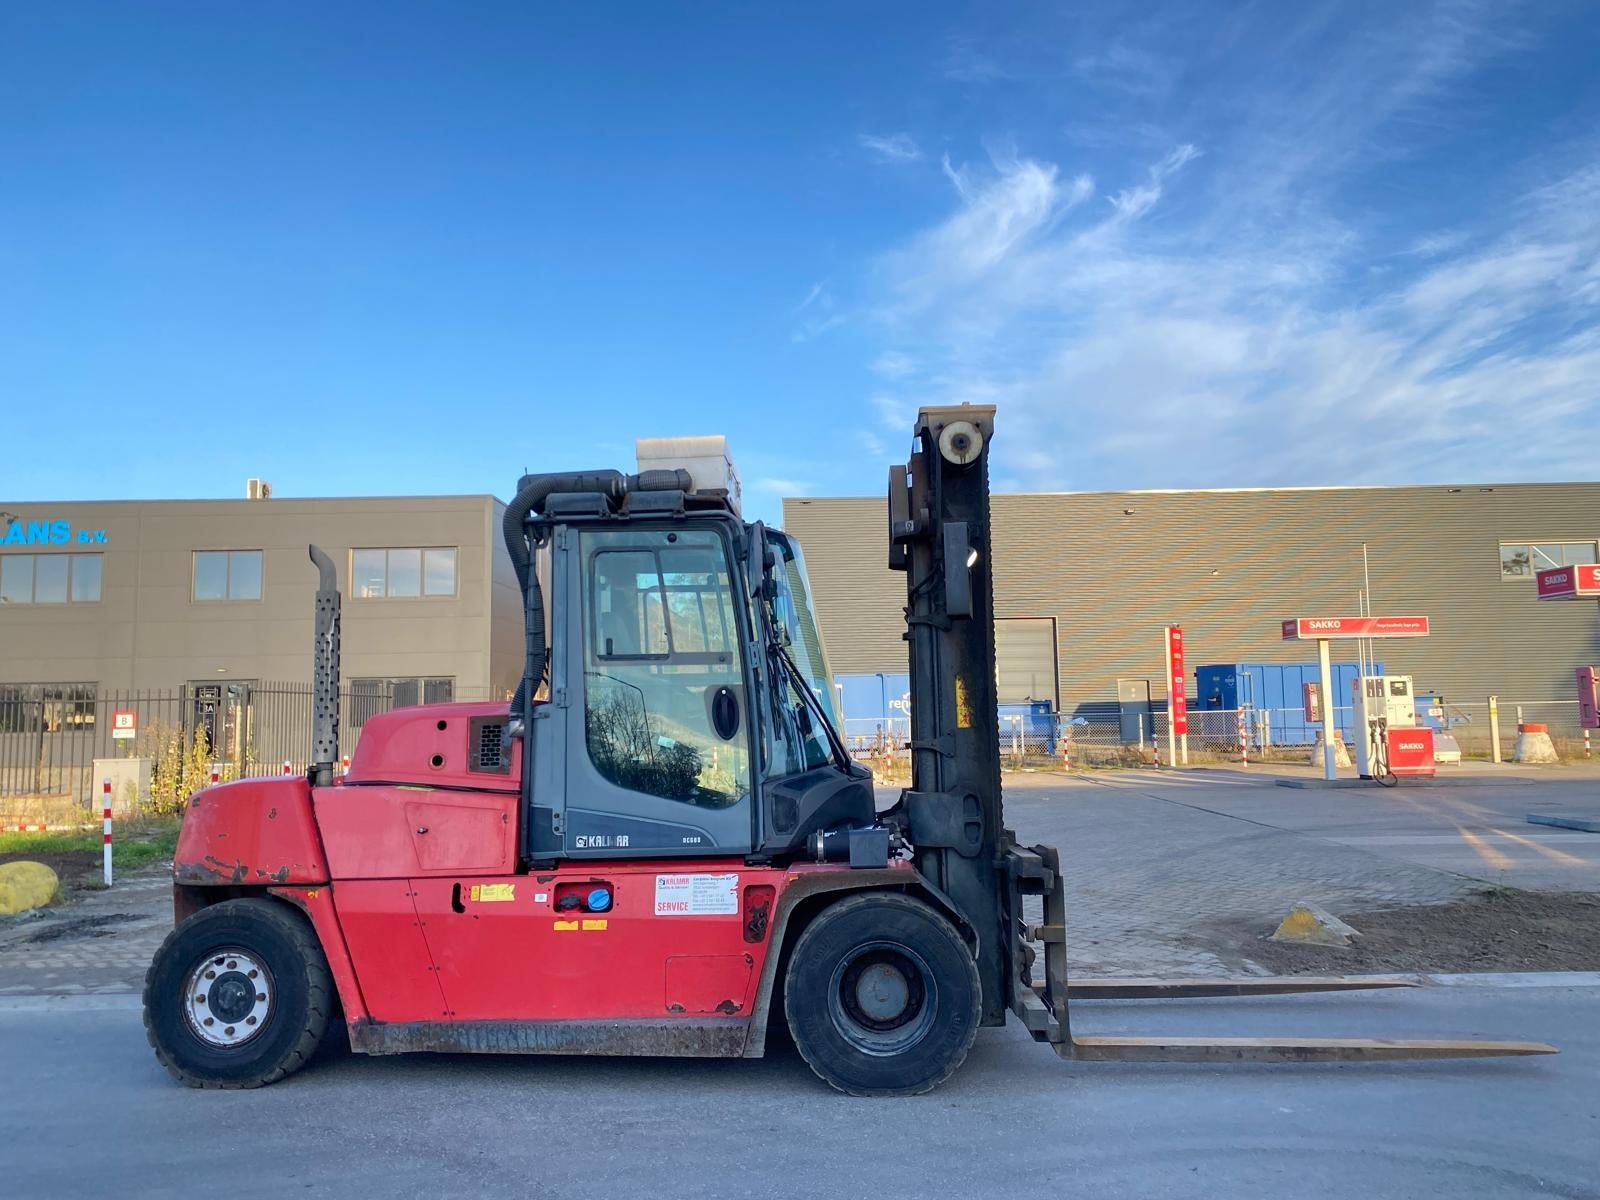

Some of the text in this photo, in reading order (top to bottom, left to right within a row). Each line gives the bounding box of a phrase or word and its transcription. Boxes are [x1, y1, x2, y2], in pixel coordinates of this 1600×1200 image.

[0, 519, 71, 545] ANS
[1544, 574, 1568, 585] SAKKO
[1309, 620, 1341, 629] SAKKO
[588, 835, 629, 848] KALAR
[657, 902, 689, 912] SERVICE
